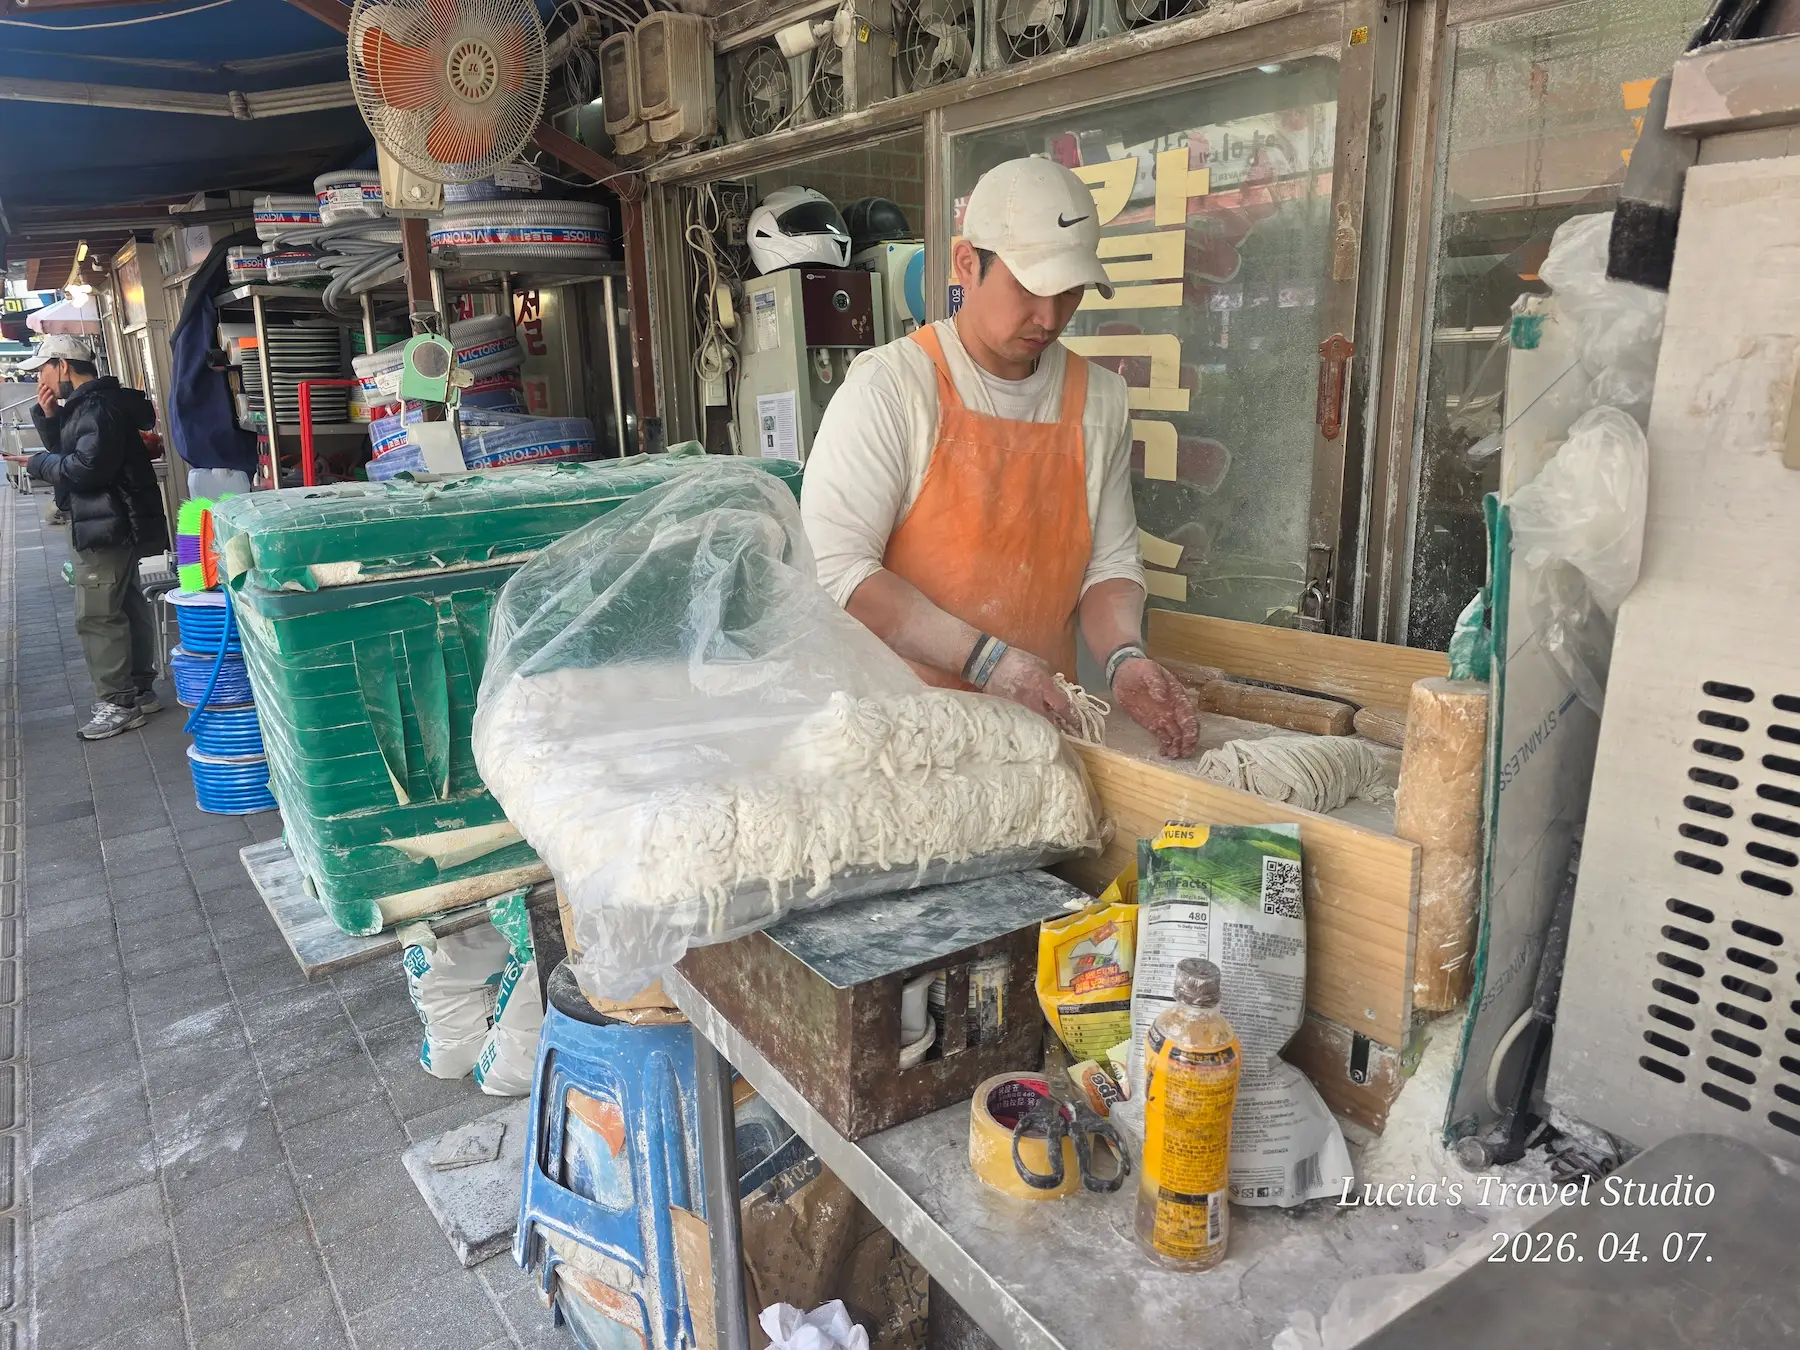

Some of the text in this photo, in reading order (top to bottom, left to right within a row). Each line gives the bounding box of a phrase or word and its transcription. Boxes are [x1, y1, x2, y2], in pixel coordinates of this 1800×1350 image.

[563, 230, 592, 242] HOSE
[459, 342, 502, 359] VICTORY
[467, 445, 552, 470] VICTORY HOS
[1499, 710, 1557, 791] STAINLESS
[1176, 879, 1208, 889] Facts
[1188, 911, 1207, 921] 480
